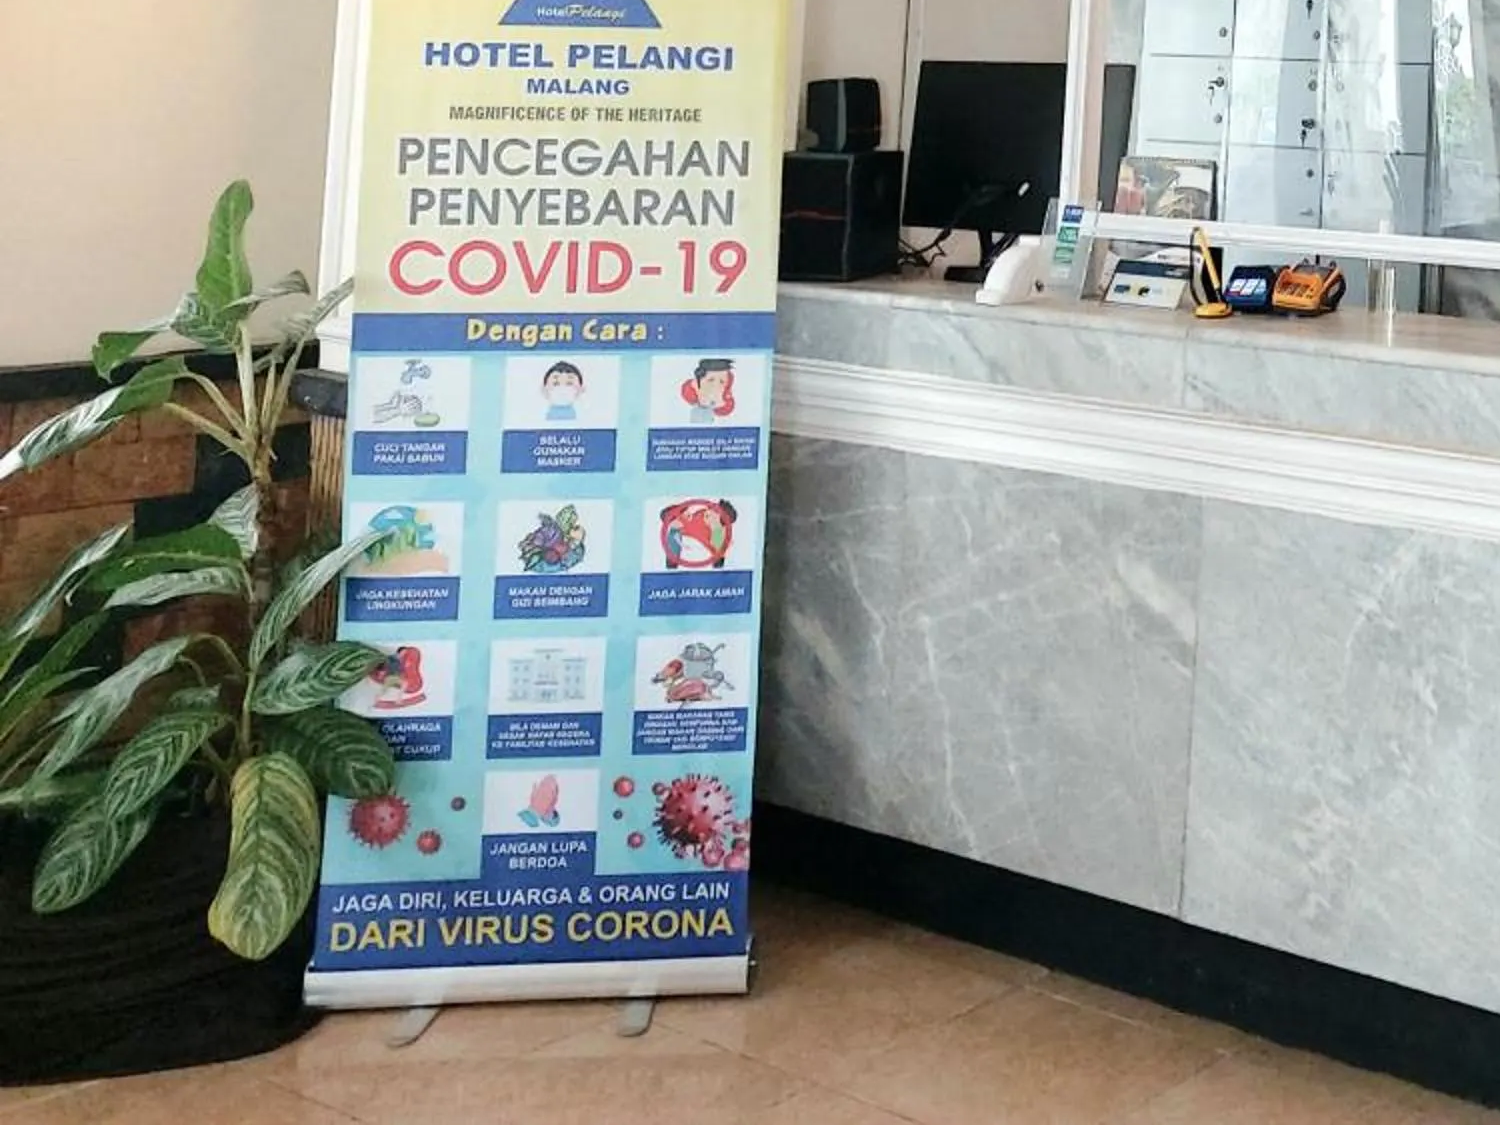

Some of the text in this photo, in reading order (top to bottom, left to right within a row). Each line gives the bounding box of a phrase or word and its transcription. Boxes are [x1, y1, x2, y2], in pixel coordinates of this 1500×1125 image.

[537, 6, 566, 18] Hotel
[425, 42, 733, 71] HOTEL PELANGI
[527, 78, 629, 94] MALANG
[449, 106, 702, 123] MAGNIFICENCE OF THE HERITAGE
[400, 137, 750, 177] PENCEGAHAN
[409, 187, 735, 227] PENYEBARAN
[389, 240, 748, 296] COVID-19
[467, 318, 572, 348] Dengan
[582, 318, 648, 341] Cara
[489, 841, 587, 855] JANGAN LUPA
[509, 856, 567, 870] BERDOA
[332, 882, 729, 913] JAGA DIRI, KELUARGA & ORANG LAIN
[329, 907, 735, 952] DARI VIRUS CORONA
